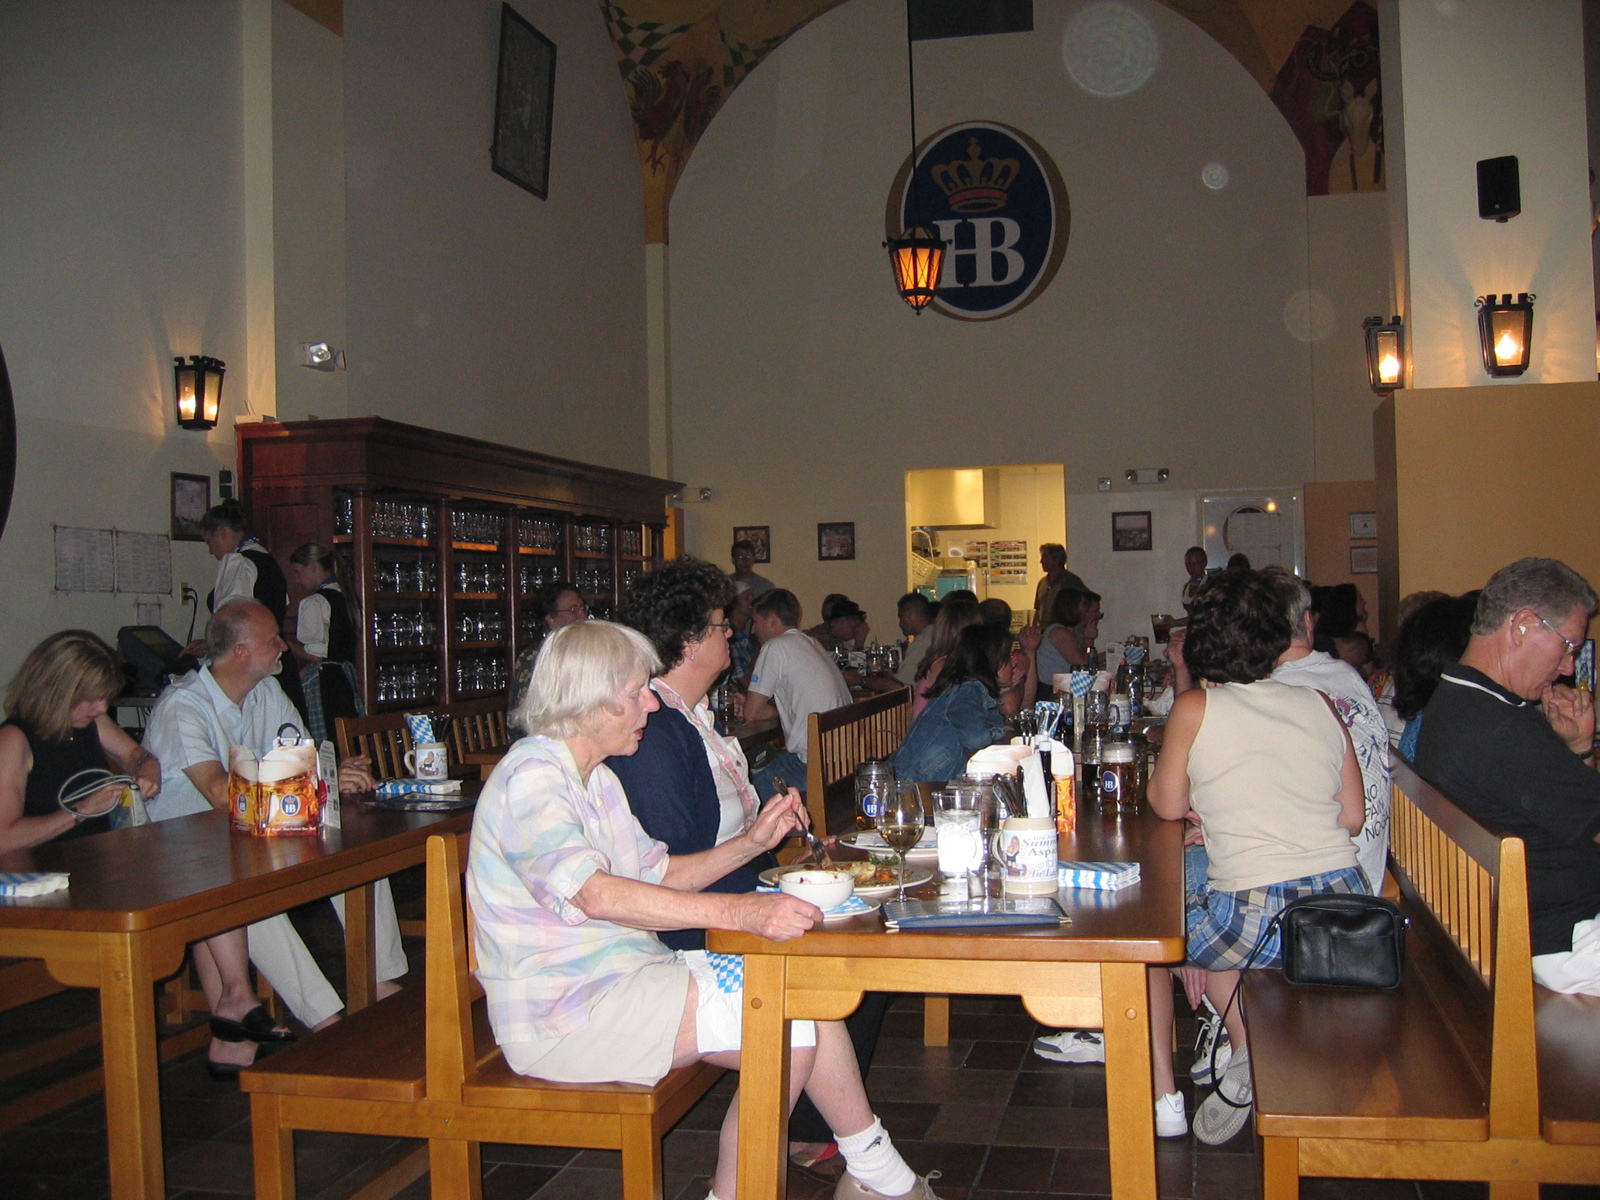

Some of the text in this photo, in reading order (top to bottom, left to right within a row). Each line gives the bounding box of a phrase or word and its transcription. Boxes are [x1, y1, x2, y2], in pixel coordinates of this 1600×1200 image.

[932, 217, 1025, 289] HB
[1104, 780, 1114, 789] HB
[285, 804, 297, 813] HB
[866, 804, 877, 814] HB
